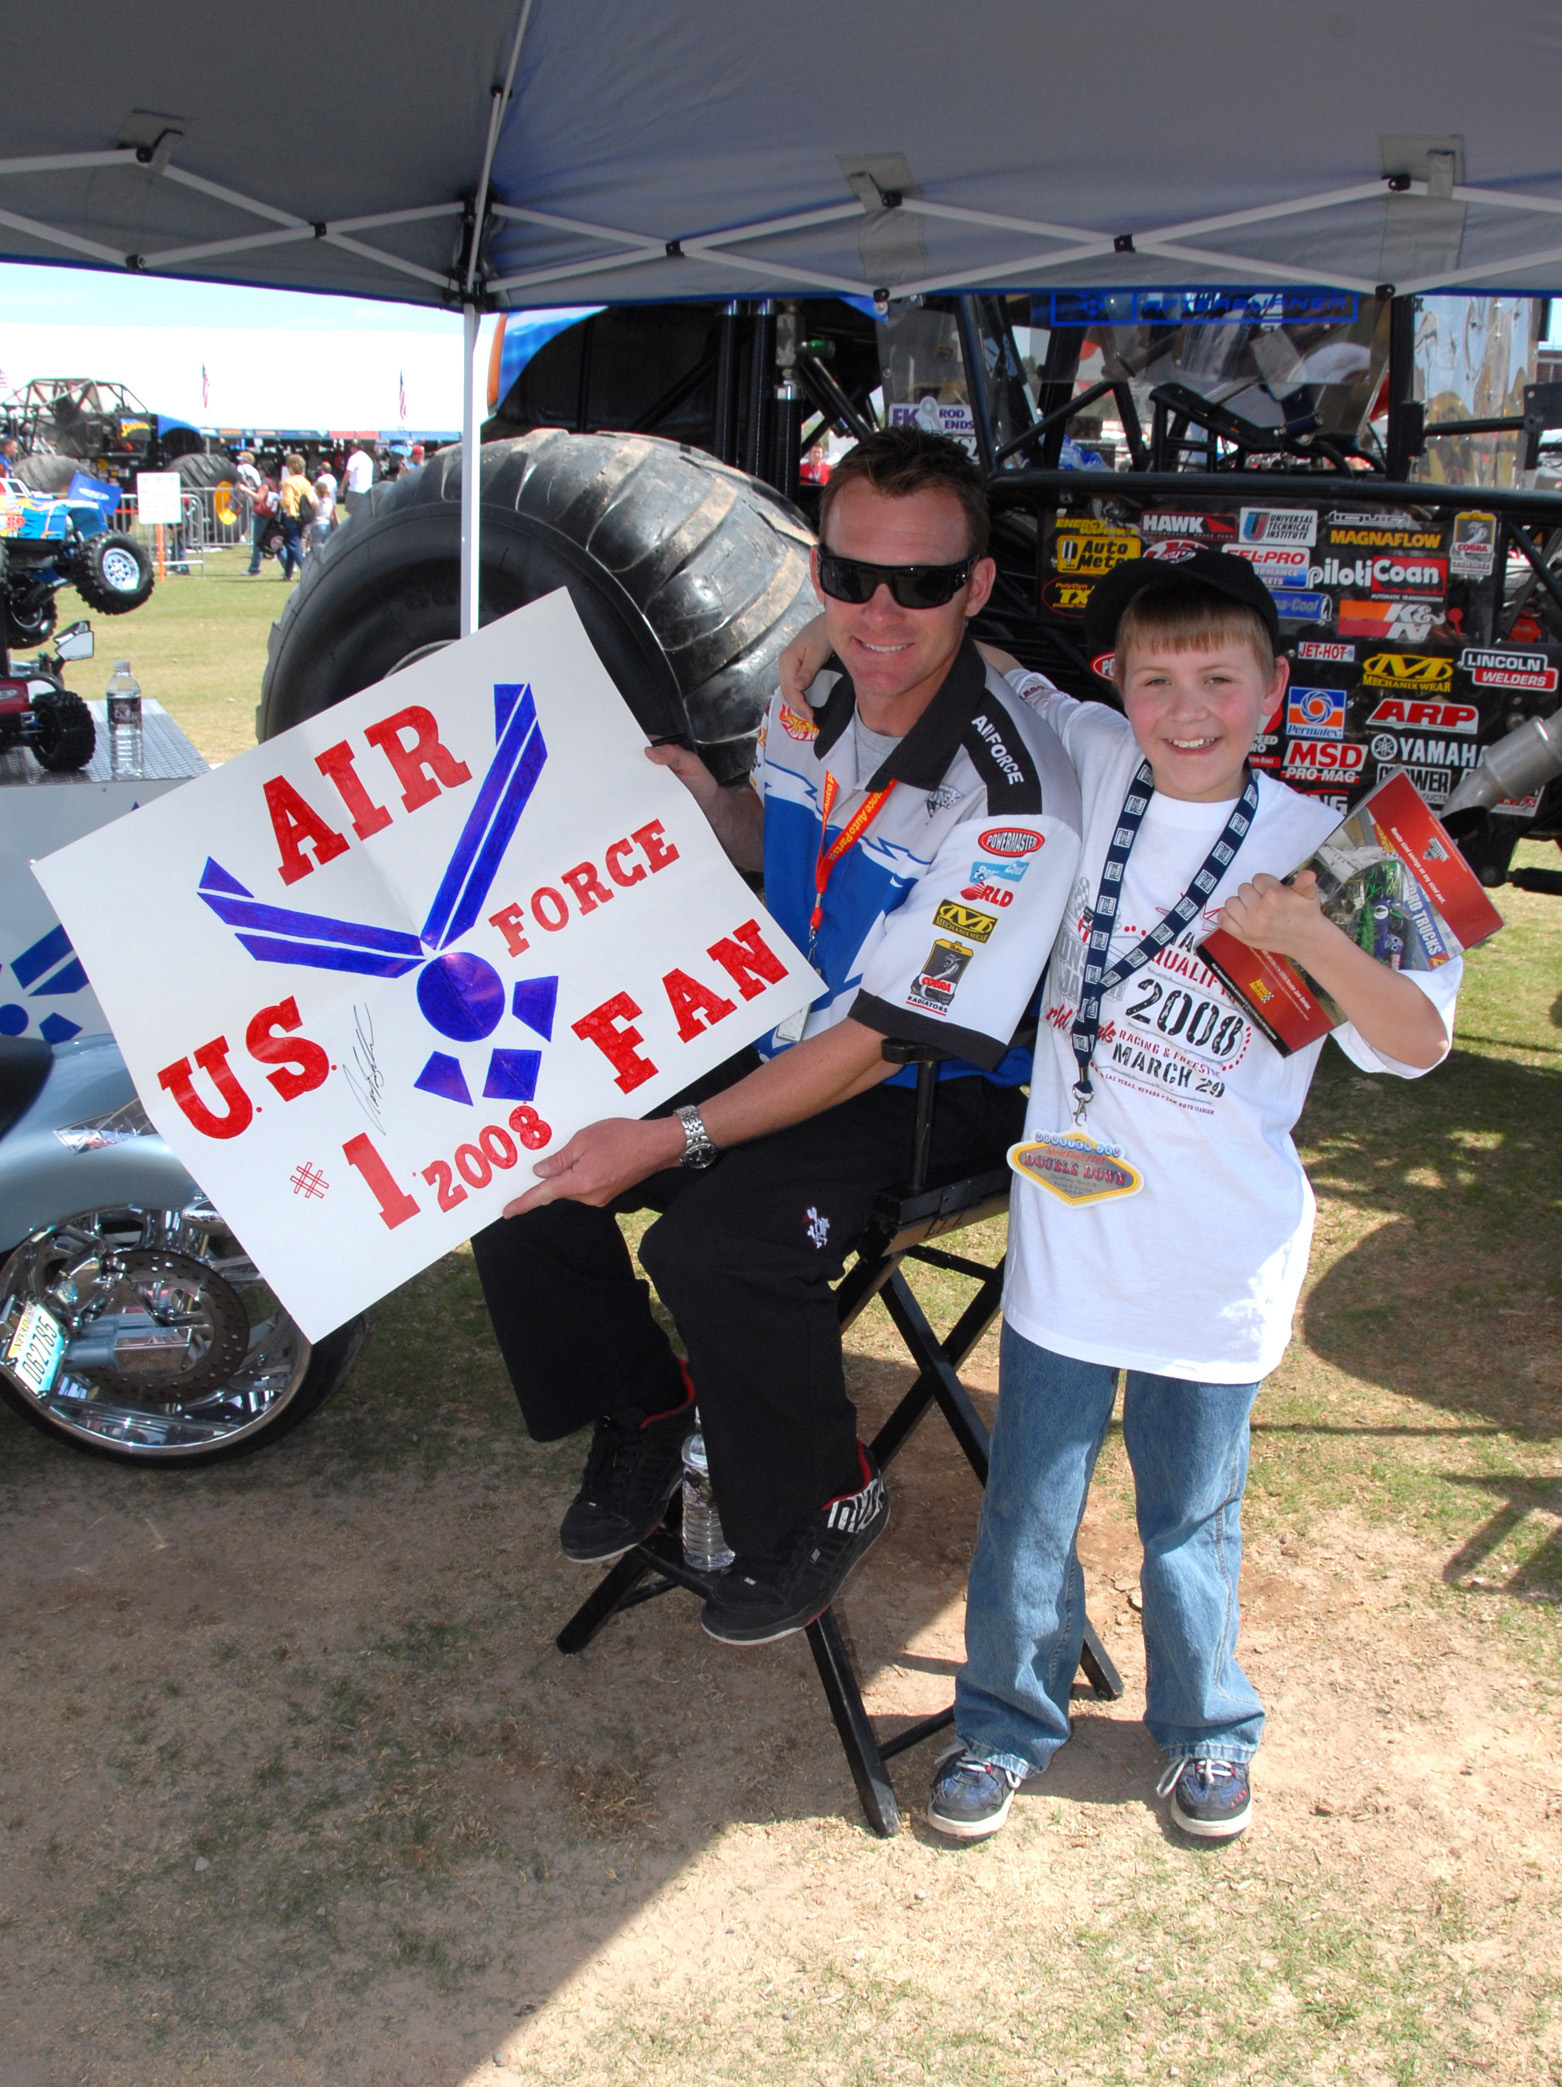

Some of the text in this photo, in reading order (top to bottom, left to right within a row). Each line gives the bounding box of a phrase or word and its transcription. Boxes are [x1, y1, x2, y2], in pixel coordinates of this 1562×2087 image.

[893, 408, 920, 427] FK
[939, 409, 965, 418] ROD
[944, 420, 975, 430] ENDS
[1055, 518, 1108, 529] ENERGY
[1143, 514, 1204, 533] HAWK
[1267, 522, 1311, 532] TECHNICAL
[1269, 514, 1314, 524] UNIVERSAL
[1265, 530, 1308, 540] INSTITUTE
[1330, 529, 1442, 548] MAGNAFLOW
[1083, 540, 1129, 554] Auto
[1457, 543, 1488, 552] COBRA
[1076, 555, 1128, 570] Mete
[1373, 558, 1440, 584] Coan
[1306, 558, 1372, 589] piloti
[1299, 642, 1347, 660] JET-HOT
[1467, 652, 1542, 672] LINCOLN
[1362, 674, 1452, 693] MECHANIX WEAR
[1481, 672, 1547, 687] WELDERS
[1371, 700, 1477, 727] ARP
[1288, 724, 1339, 738] Permatex
[1288, 741, 1363, 769] MSD
[262, 704, 473, 886] AIR
[849, 813, 868, 841] Auto
[986, 832, 1037, 852] POWERMASTER
[489, 817, 682, 959] FORCE
[935, 916, 988, 941] MECHANIX WEAR
[1411, 910, 1444, 956] TRUCKS
[921, 975, 952, 993] COBRA
[572, 918, 790, 1096] FAN
[907, 995, 948, 1013] RADIATORS
[1125, 978, 1244, 1057] 2008
[1119, 1029, 1160, 1054] RACING
[1163, 1047, 1170, 1058] &
[1112, 1042, 1226, 1098] MARCH 29
[1035, 1131, 1121, 1158] MONSTER JAM
[1024, 1153, 1079, 1176] DOUBLE
[1083, 1165, 1127, 1186] DOWN
